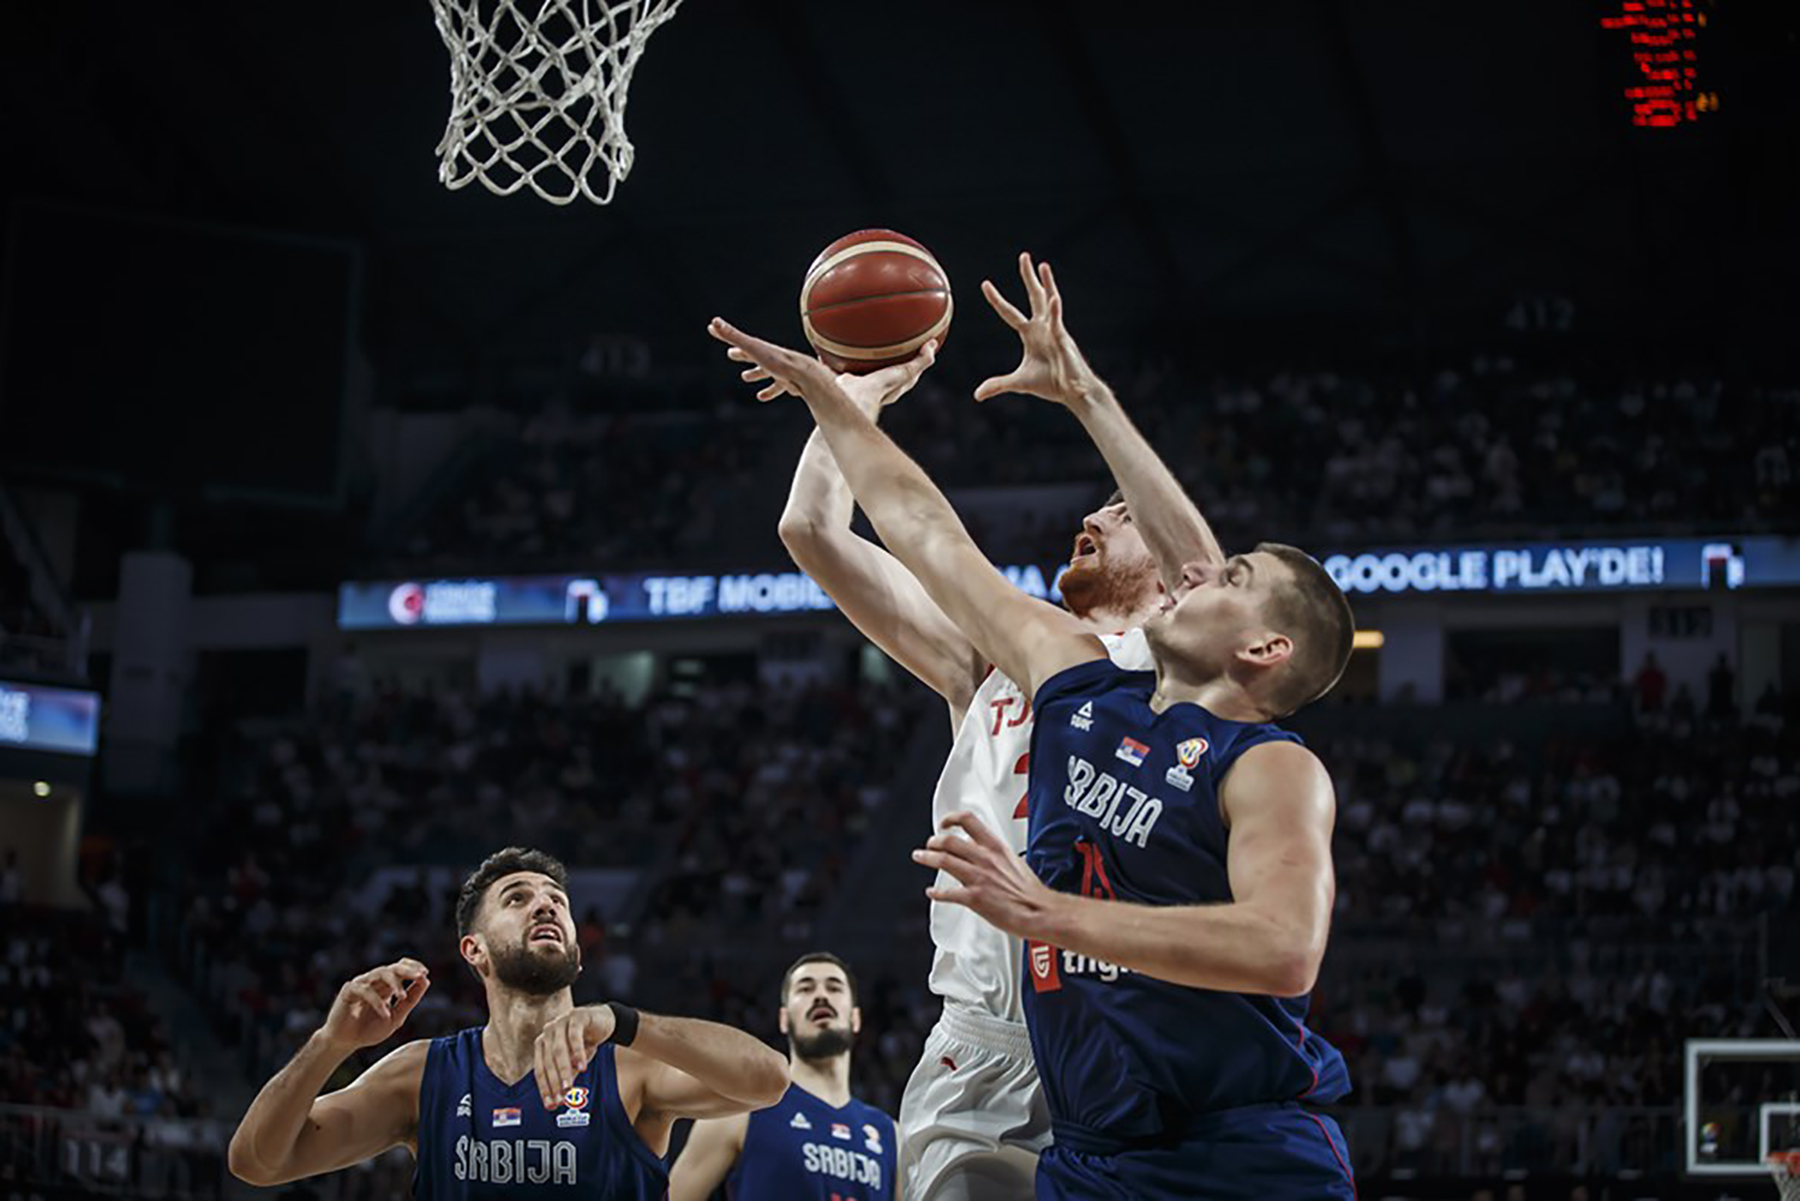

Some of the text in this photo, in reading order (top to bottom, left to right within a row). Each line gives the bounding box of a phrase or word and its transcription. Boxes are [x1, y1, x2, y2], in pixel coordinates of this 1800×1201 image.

[1324, 546, 1664, 593] GOOGLE PLAY'DE!
[643, 575, 716, 615] TBF
[454, 1135, 577, 1185] SRBIJA
[803, 1142, 881, 1190] SRBIJA
